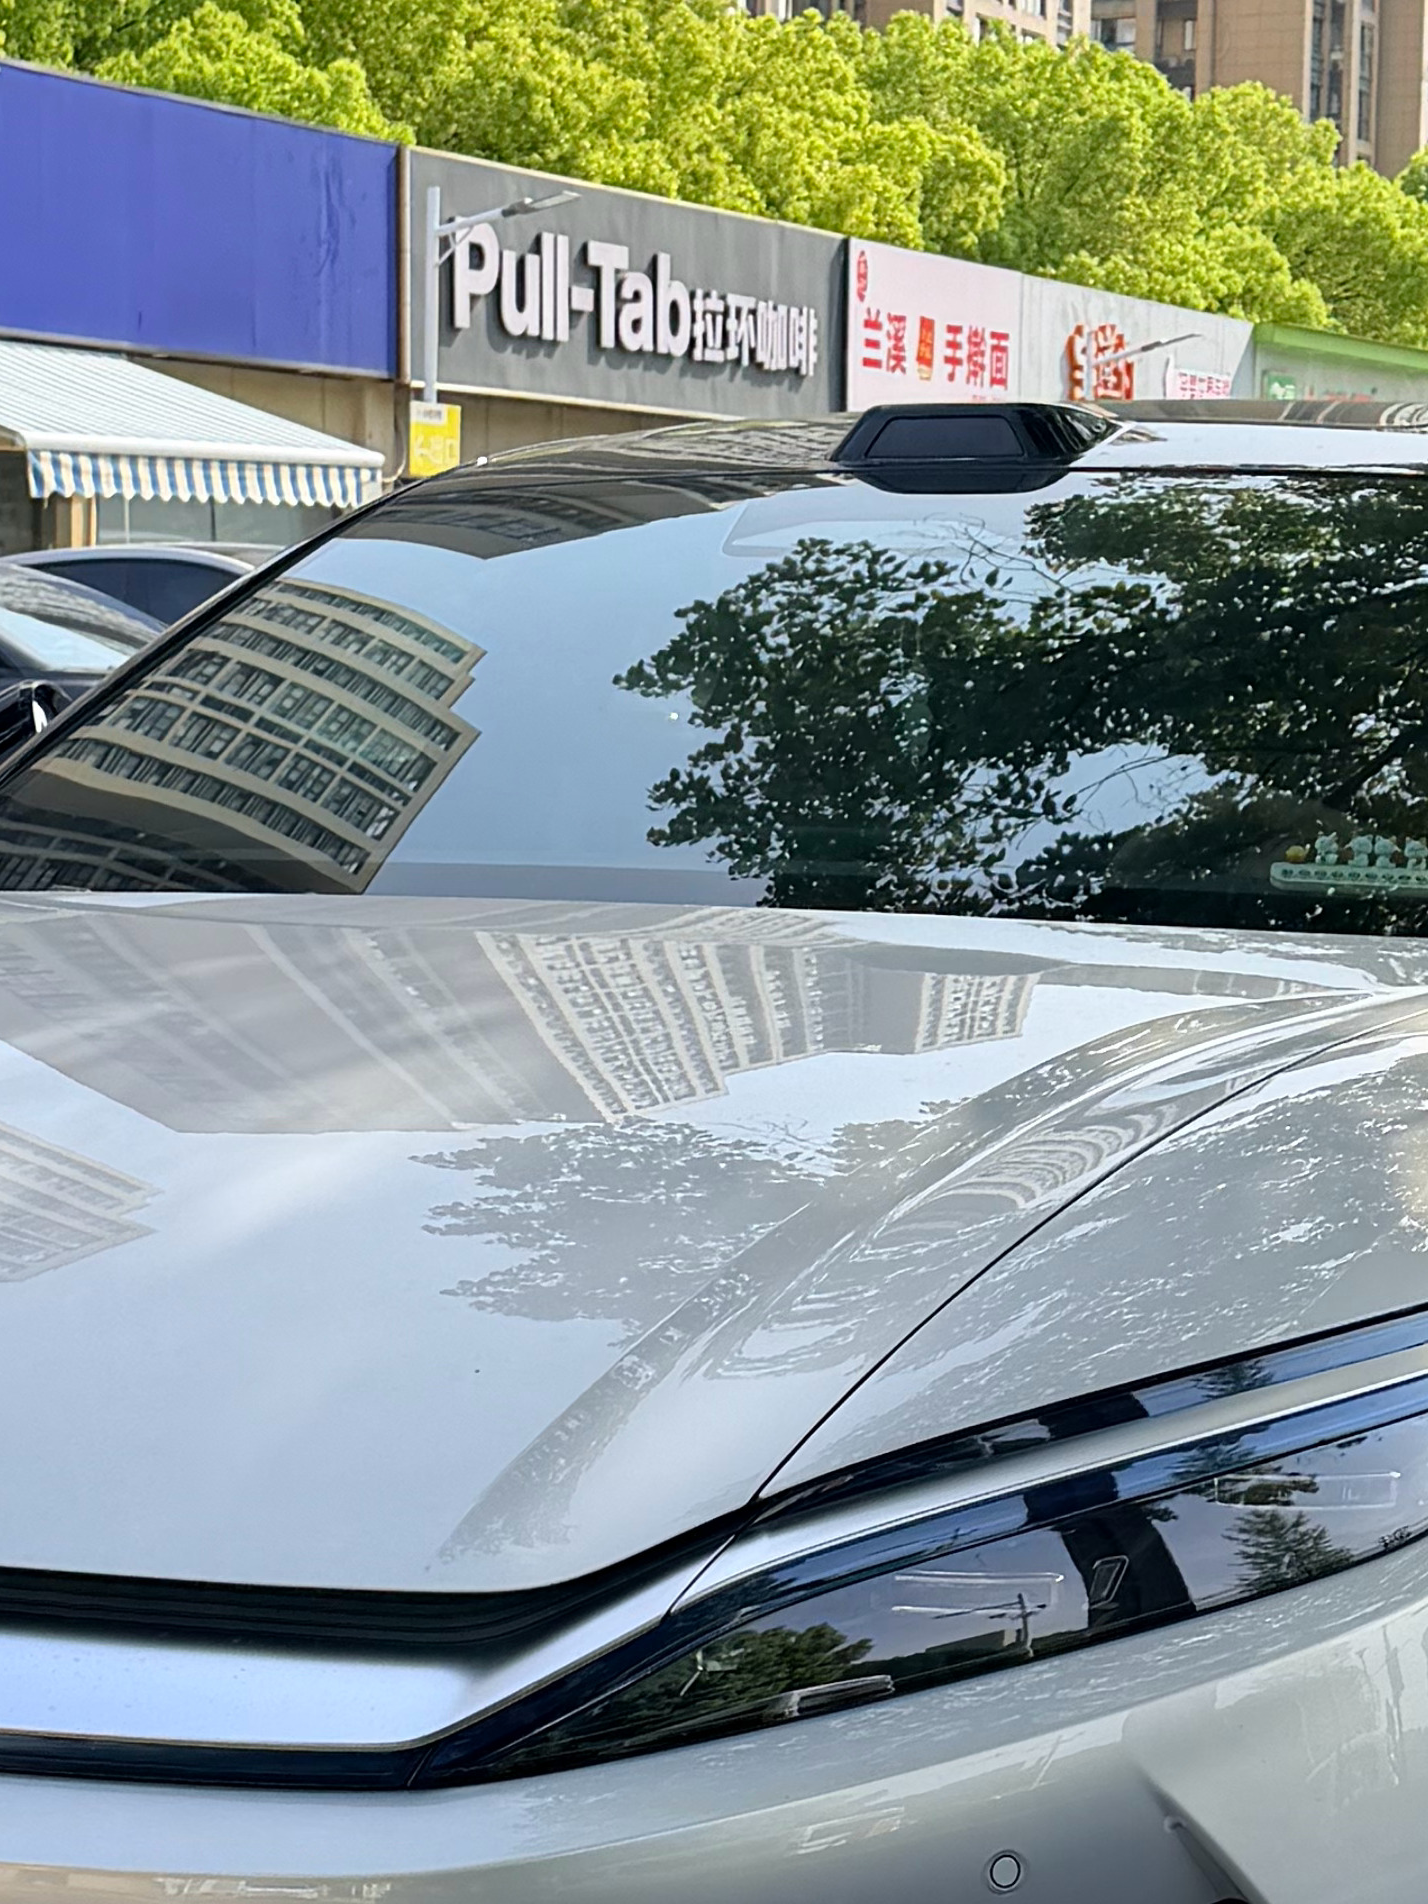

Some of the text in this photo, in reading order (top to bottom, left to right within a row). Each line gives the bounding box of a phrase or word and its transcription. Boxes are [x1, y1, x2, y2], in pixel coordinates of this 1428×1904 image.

[452, 217, 691, 356] Pull-Tab
[693, 287, 819, 377] 拉环咖啡
